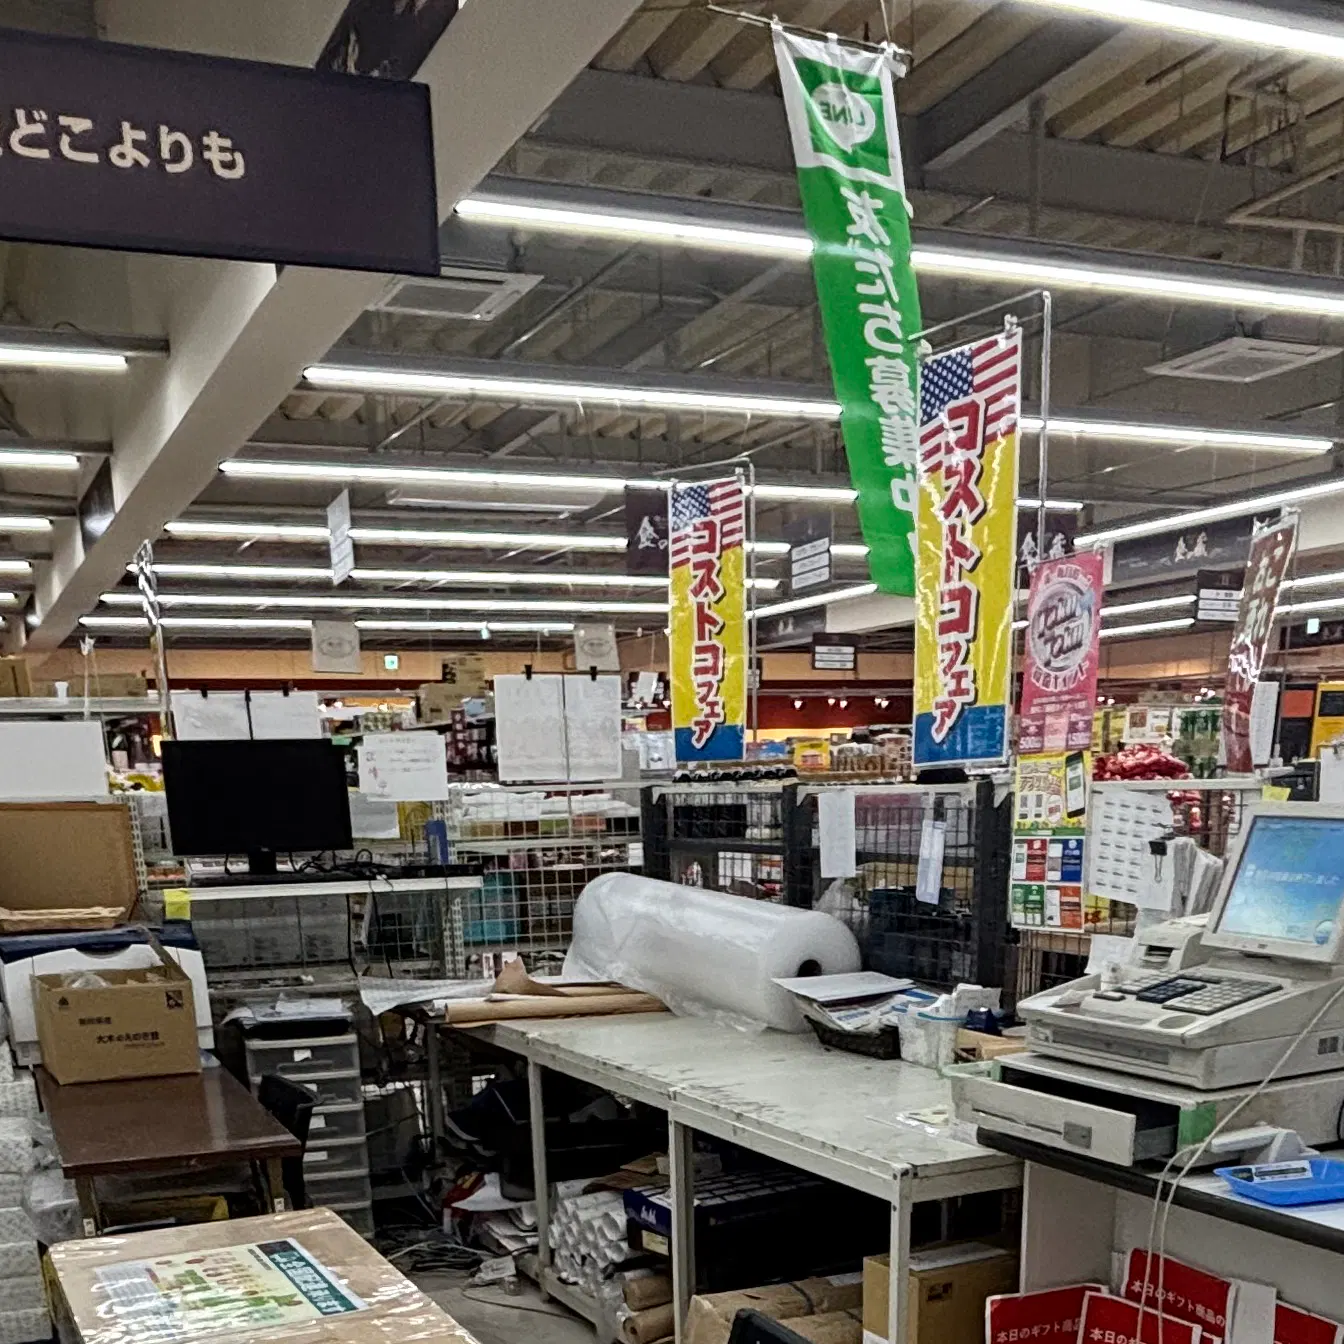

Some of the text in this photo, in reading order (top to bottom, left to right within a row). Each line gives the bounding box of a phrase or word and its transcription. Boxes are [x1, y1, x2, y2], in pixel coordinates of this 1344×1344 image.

[690, 519, 723, 747] コストコフェア
[933, 398, 982, 742] コストコフェア
[1131, 1280, 1225, 1326] 本日のギフト商品の
